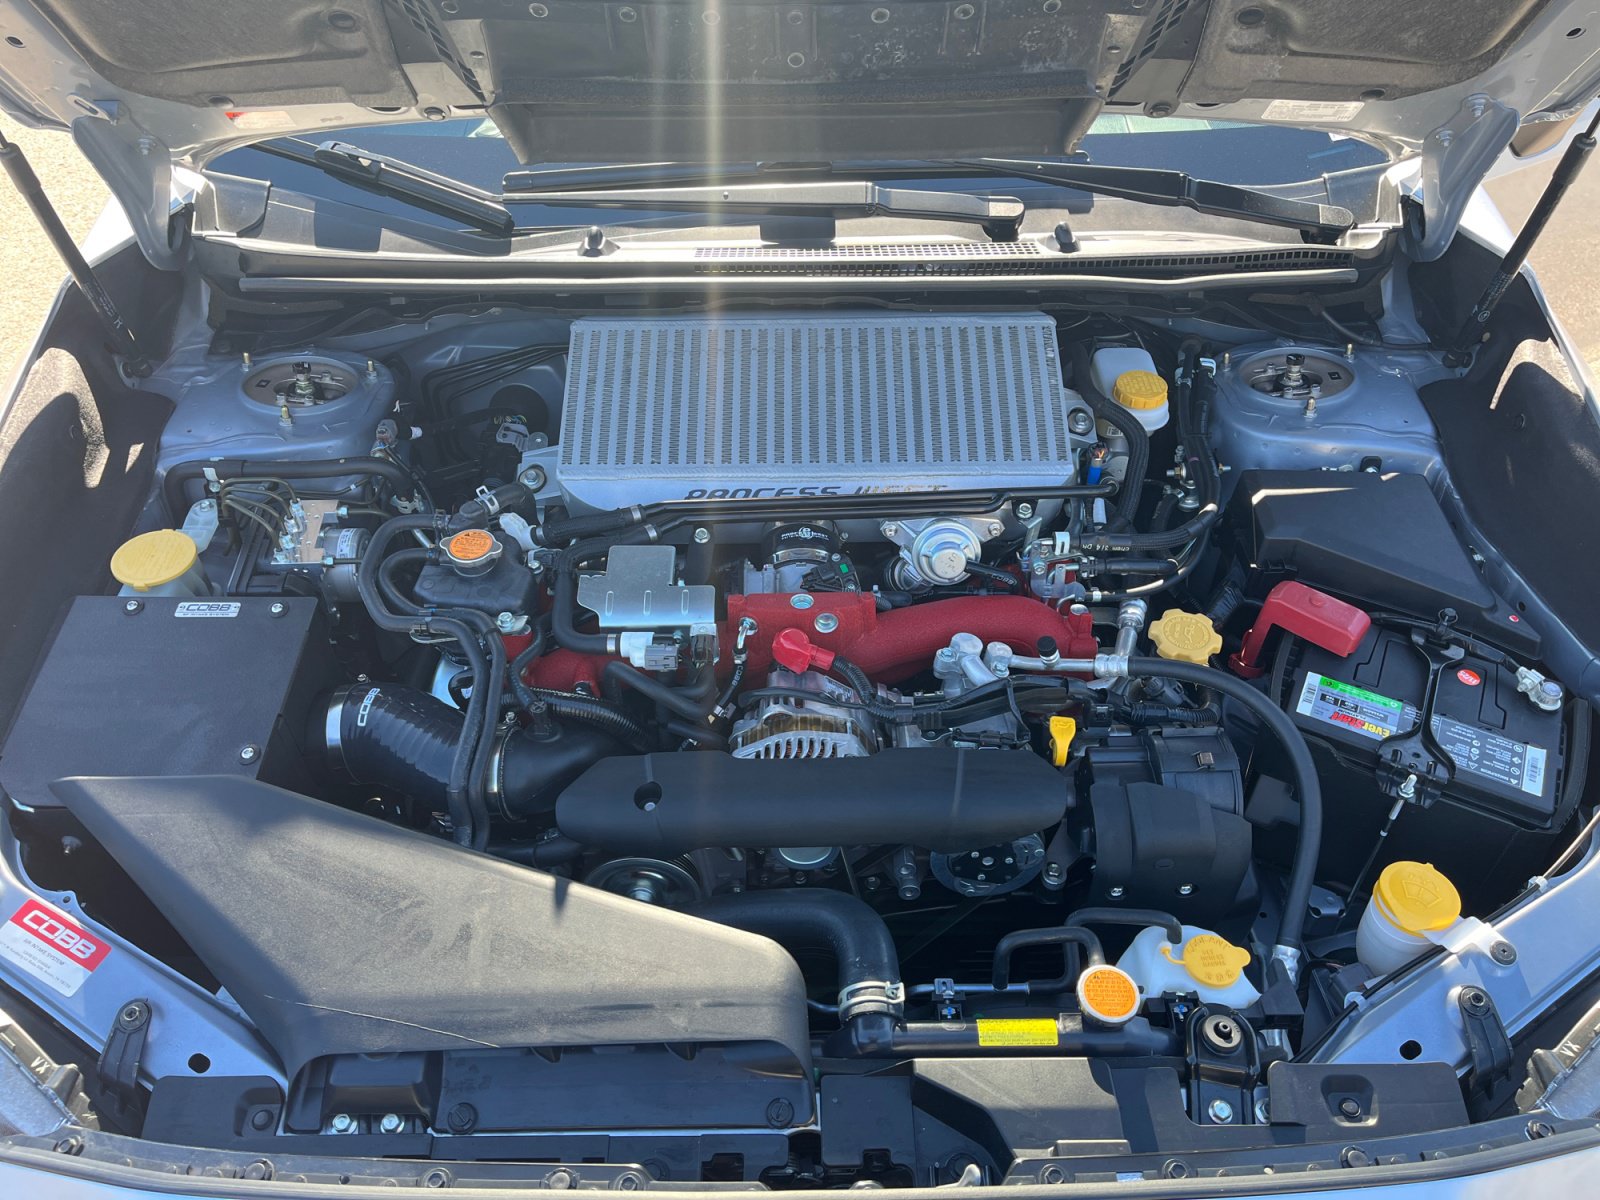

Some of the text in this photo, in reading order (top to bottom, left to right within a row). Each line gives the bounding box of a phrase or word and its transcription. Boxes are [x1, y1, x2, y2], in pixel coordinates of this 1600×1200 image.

[186, 603, 232, 612] COBB
[357, 687, 380, 726] COBB
[1331, 711, 1391, 738] EverStart
[23, 909, 97, 959] COBB
